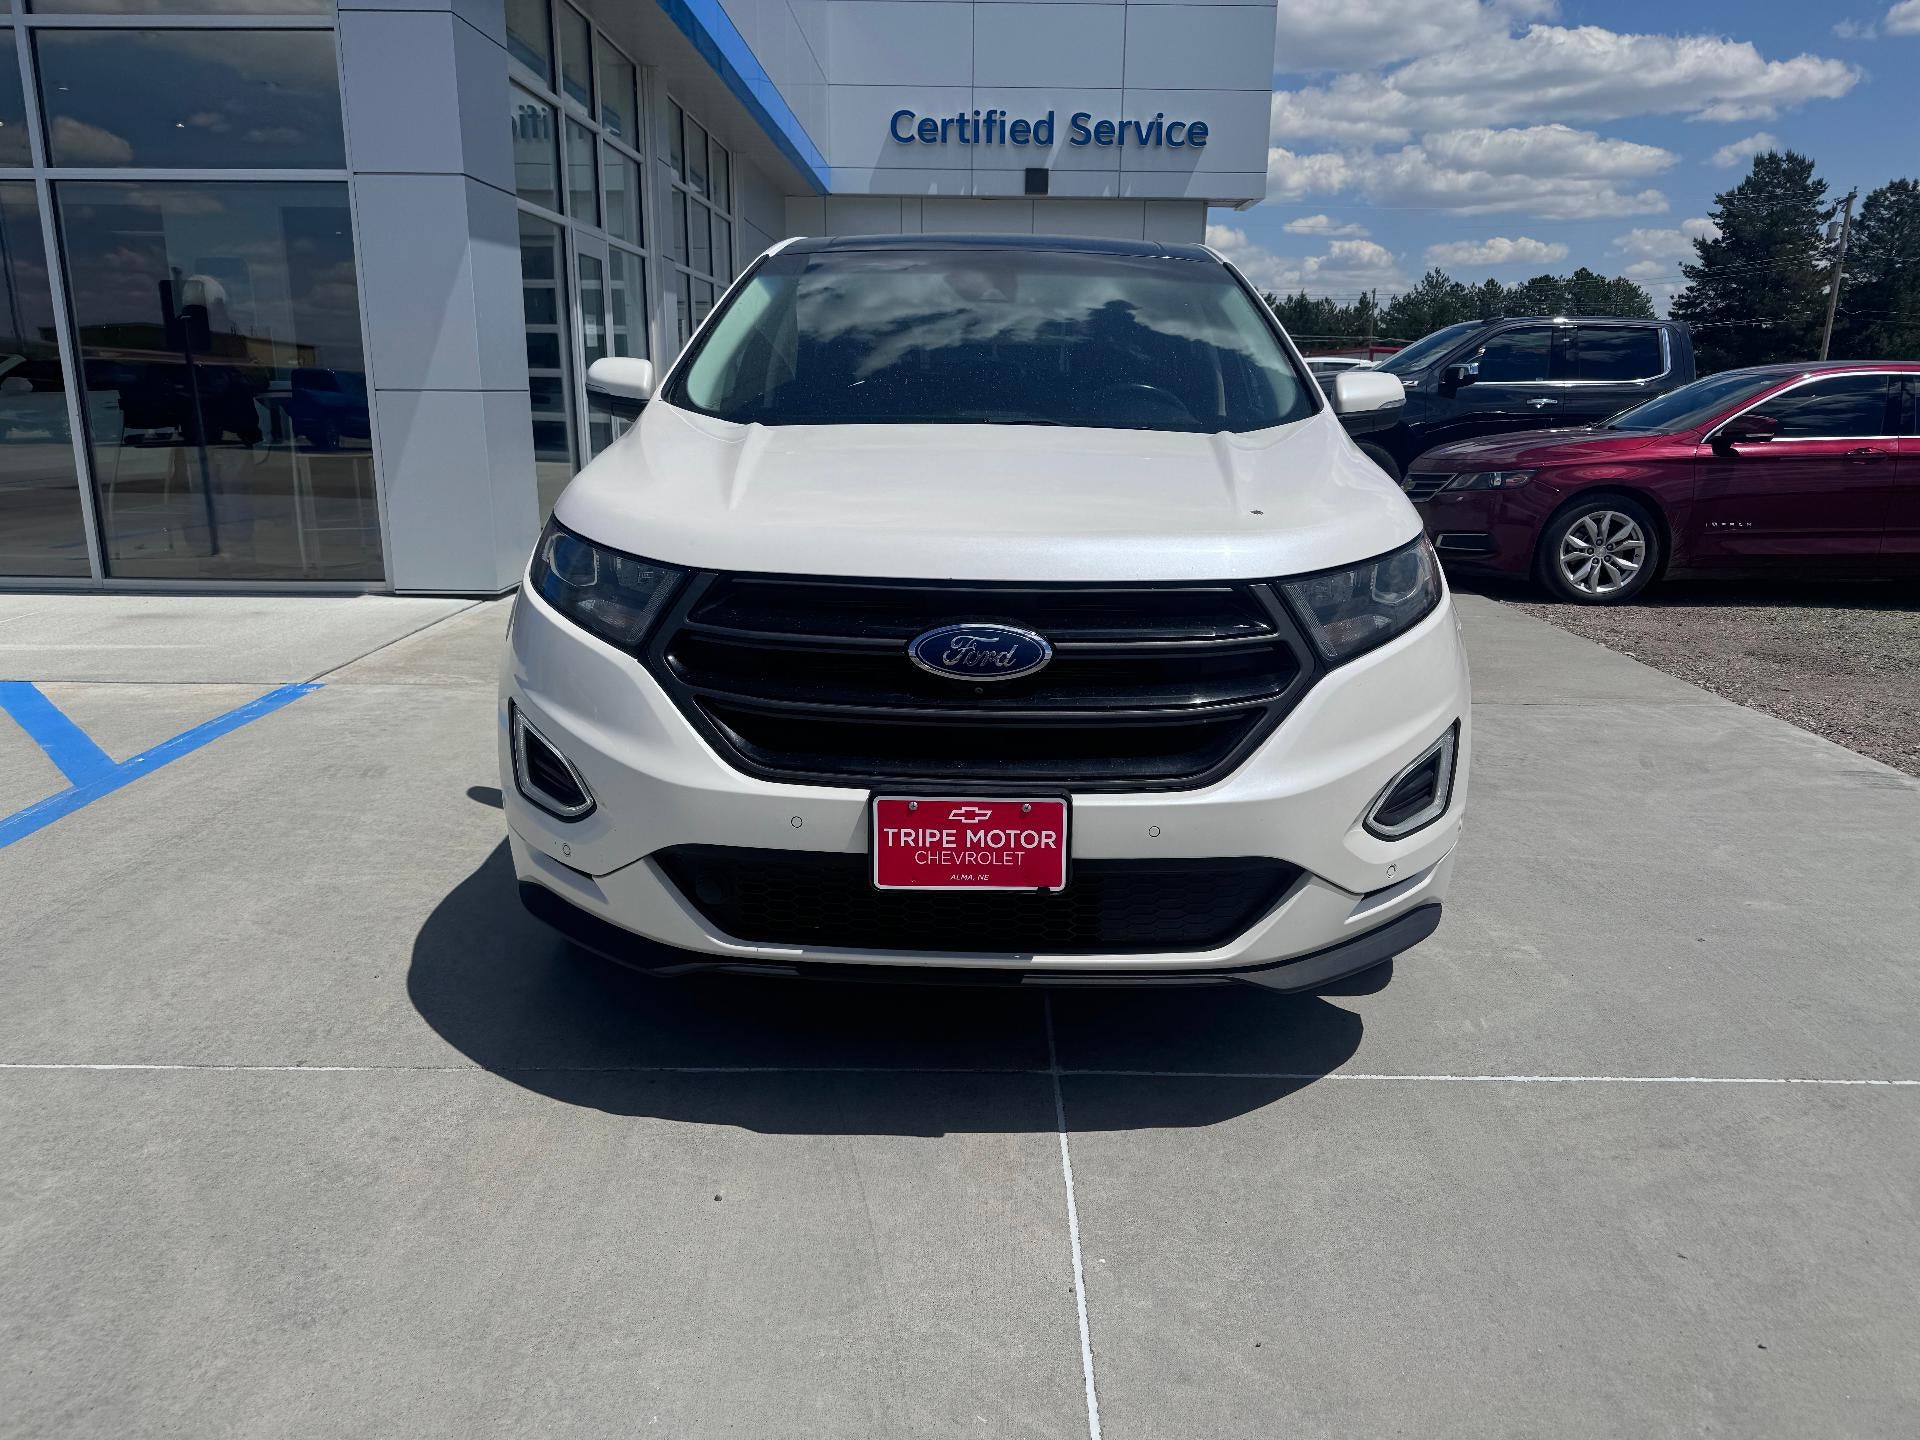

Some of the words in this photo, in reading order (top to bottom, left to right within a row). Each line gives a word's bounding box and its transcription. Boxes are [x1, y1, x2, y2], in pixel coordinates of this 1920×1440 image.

[890, 109, 1055, 145] Certified
[1070, 112, 1209, 147] Service
[942, 635, 1019, 667] Ford
[883, 828, 957, 848] TRIPE
[966, 829, 1057, 849] MOTOR
[914, 851, 1025, 866] CHEVROLET
